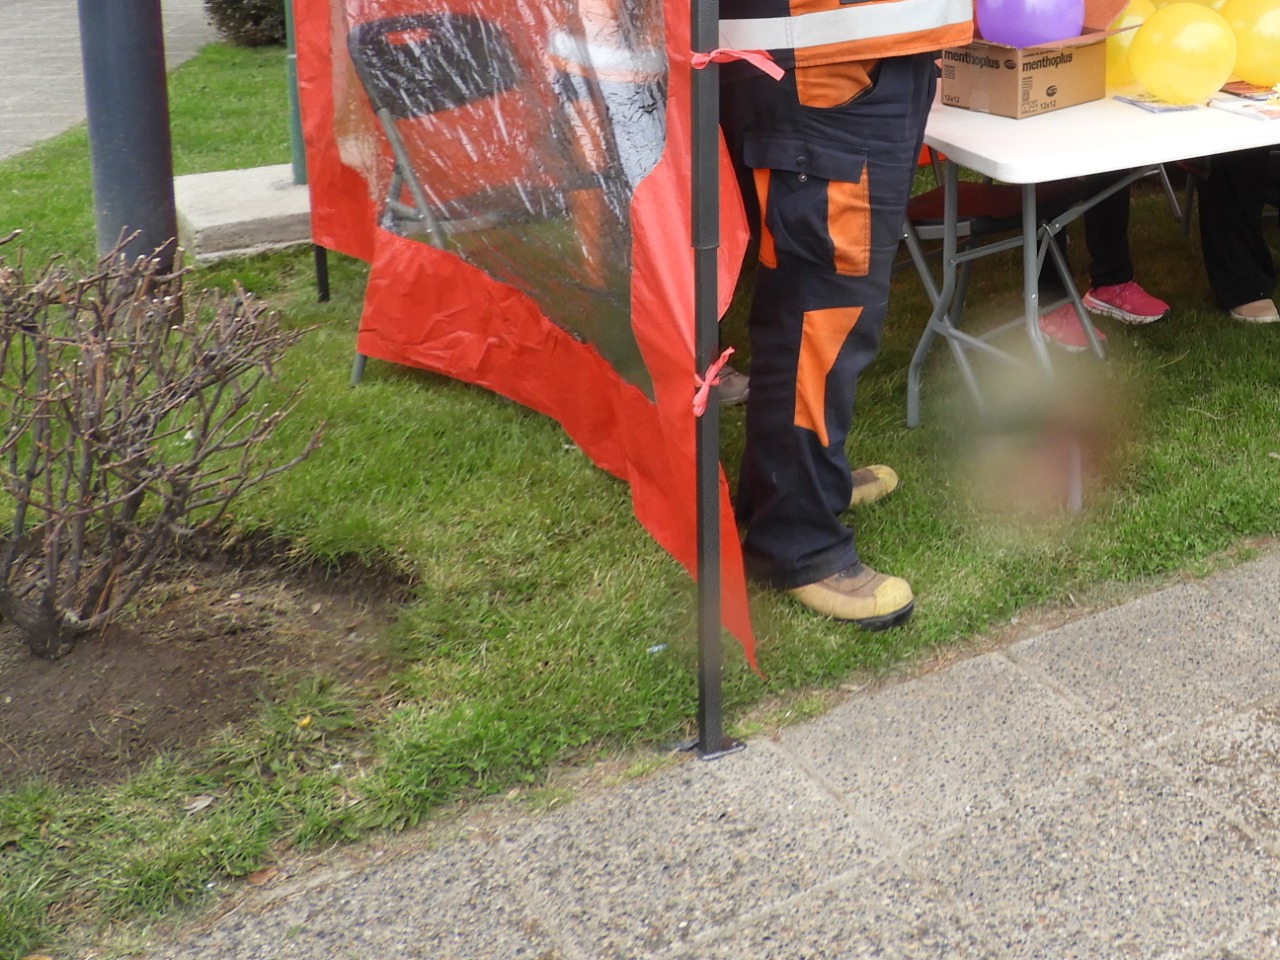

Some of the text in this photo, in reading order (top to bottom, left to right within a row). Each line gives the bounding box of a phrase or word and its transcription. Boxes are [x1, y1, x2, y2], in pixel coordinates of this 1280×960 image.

[944, 50, 1000, 69] menthoplus
[1022, 52, 1073, 72] menthoplus
[944, 94, 960, 103] 12x12
[1040, 100, 1056, 110] 12x12
